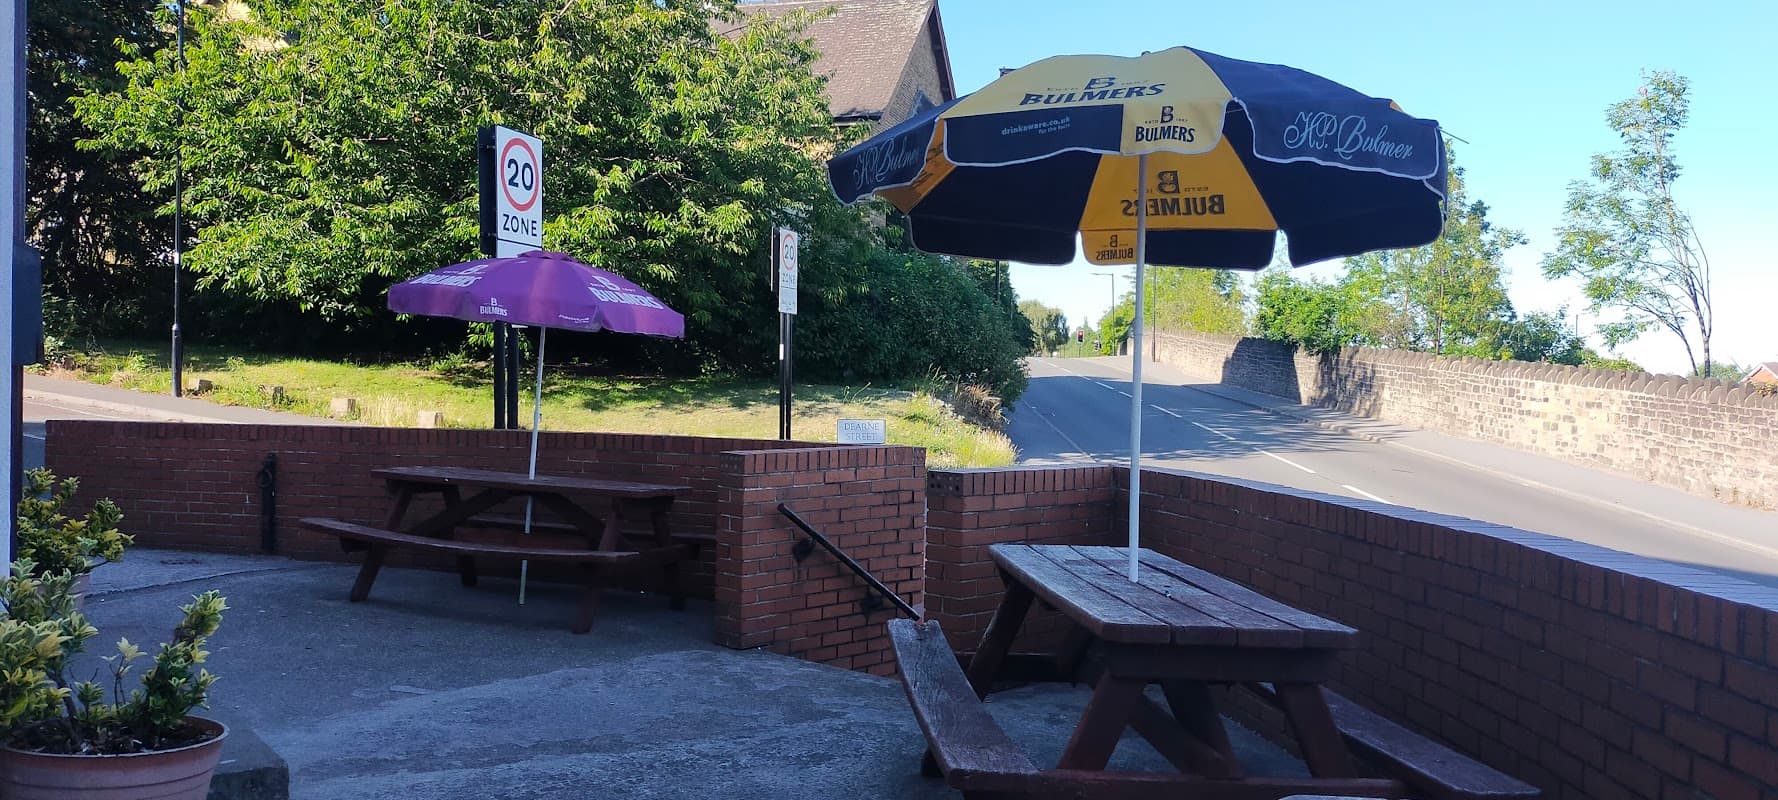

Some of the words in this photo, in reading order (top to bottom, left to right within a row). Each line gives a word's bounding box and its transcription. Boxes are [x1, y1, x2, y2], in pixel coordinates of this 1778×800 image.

[1019, 83, 1167, 106] BULMERS
[1160, 105, 1174, 124] B
[1001, 115, 1071, 136] drinkaware.co.uk
[1135, 125, 1196, 142] BULMERS
[1334, 115, 1413, 160] Bulmer
[875, 135, 924, 183] Bulm
[507, 158, 534, 191] 20
[502, 213, 538, 238] ZONE
[784, 244, 794, 260] 20
[479, 305, 508, 317] BULMERS
[844, 422, 880, 431] DEARNE
[847, 432, 877, 441] STREET
